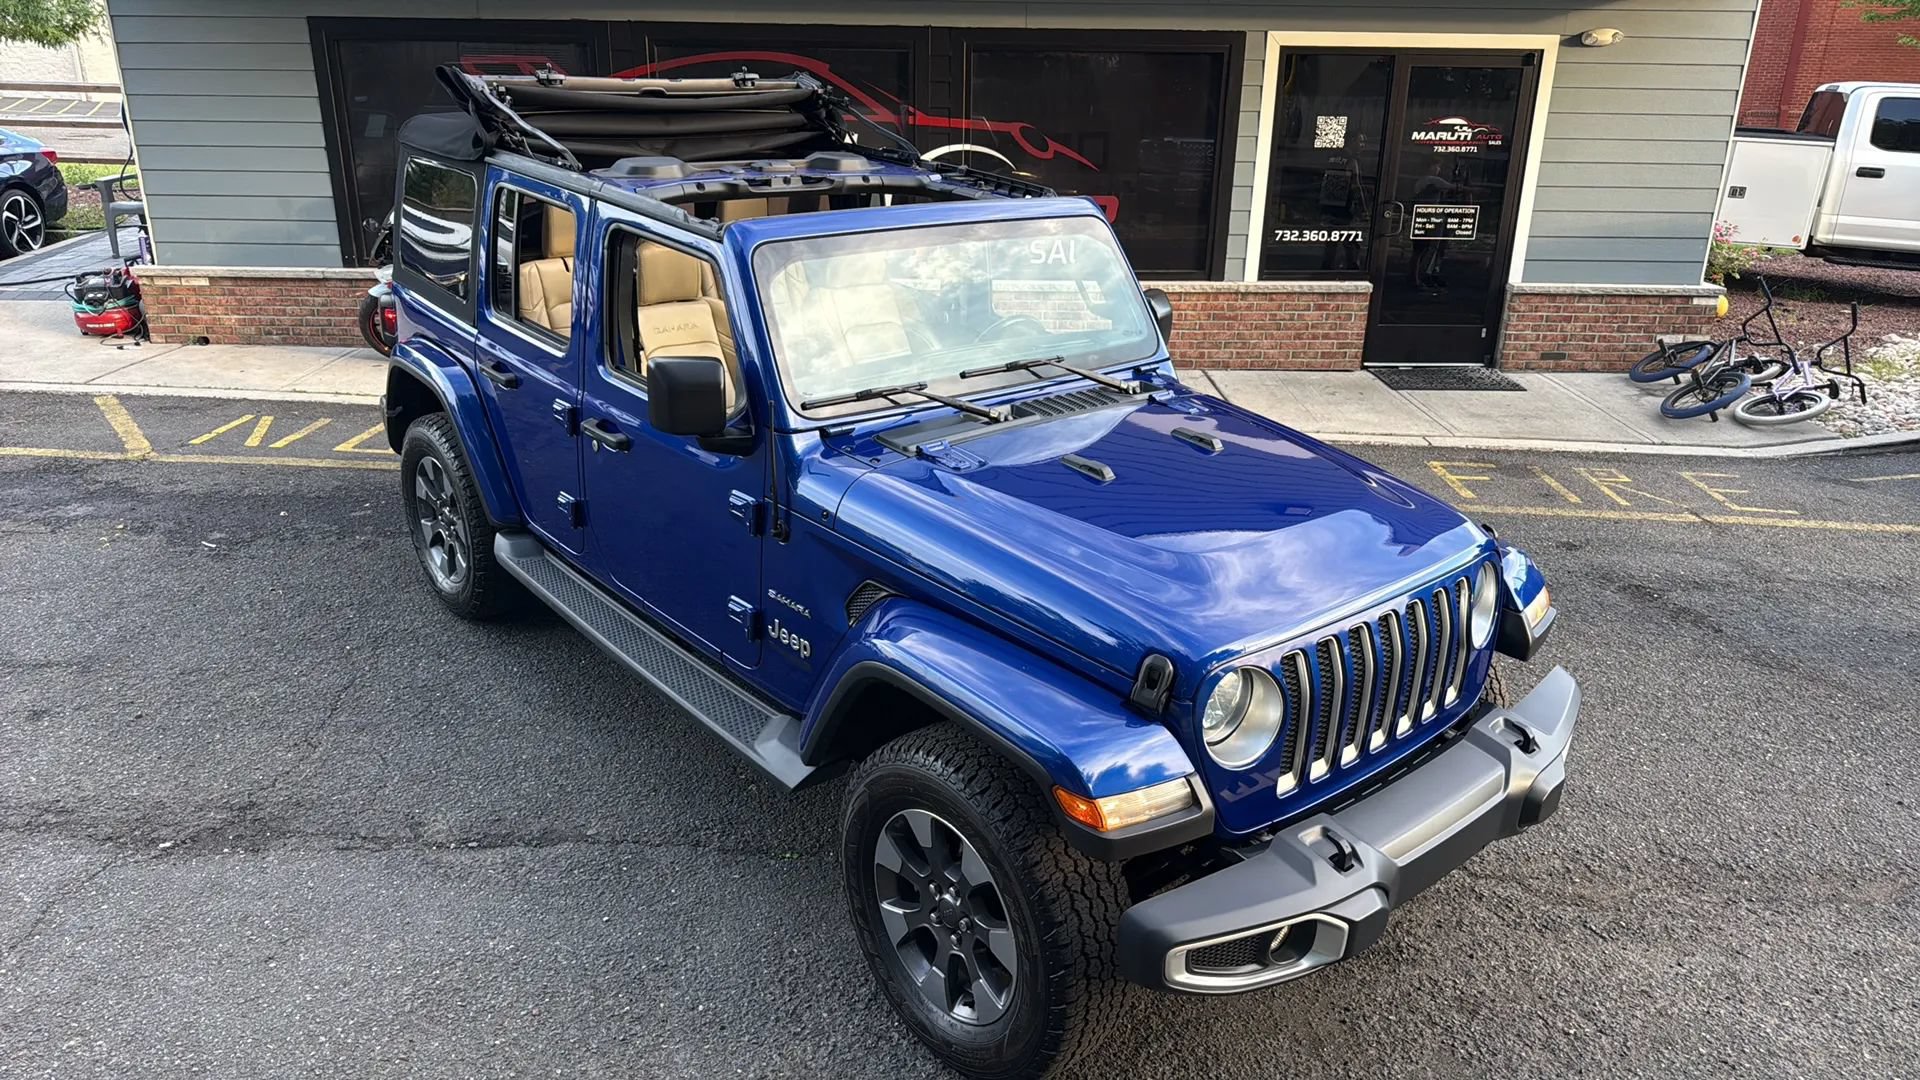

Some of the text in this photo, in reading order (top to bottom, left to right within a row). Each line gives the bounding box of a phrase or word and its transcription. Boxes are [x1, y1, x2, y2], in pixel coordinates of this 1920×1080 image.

[1411, 131, 1473, 141] MARUTI
[1433, 145, 1478, 153] 732.360.8771
[1274, 230, 1363, 242] 732.360.8771
[1424, 461, 1800, 514] FIRE
[768, 588, 811, 619] SAHARA
[767, 618, 811, 659] Jeep
